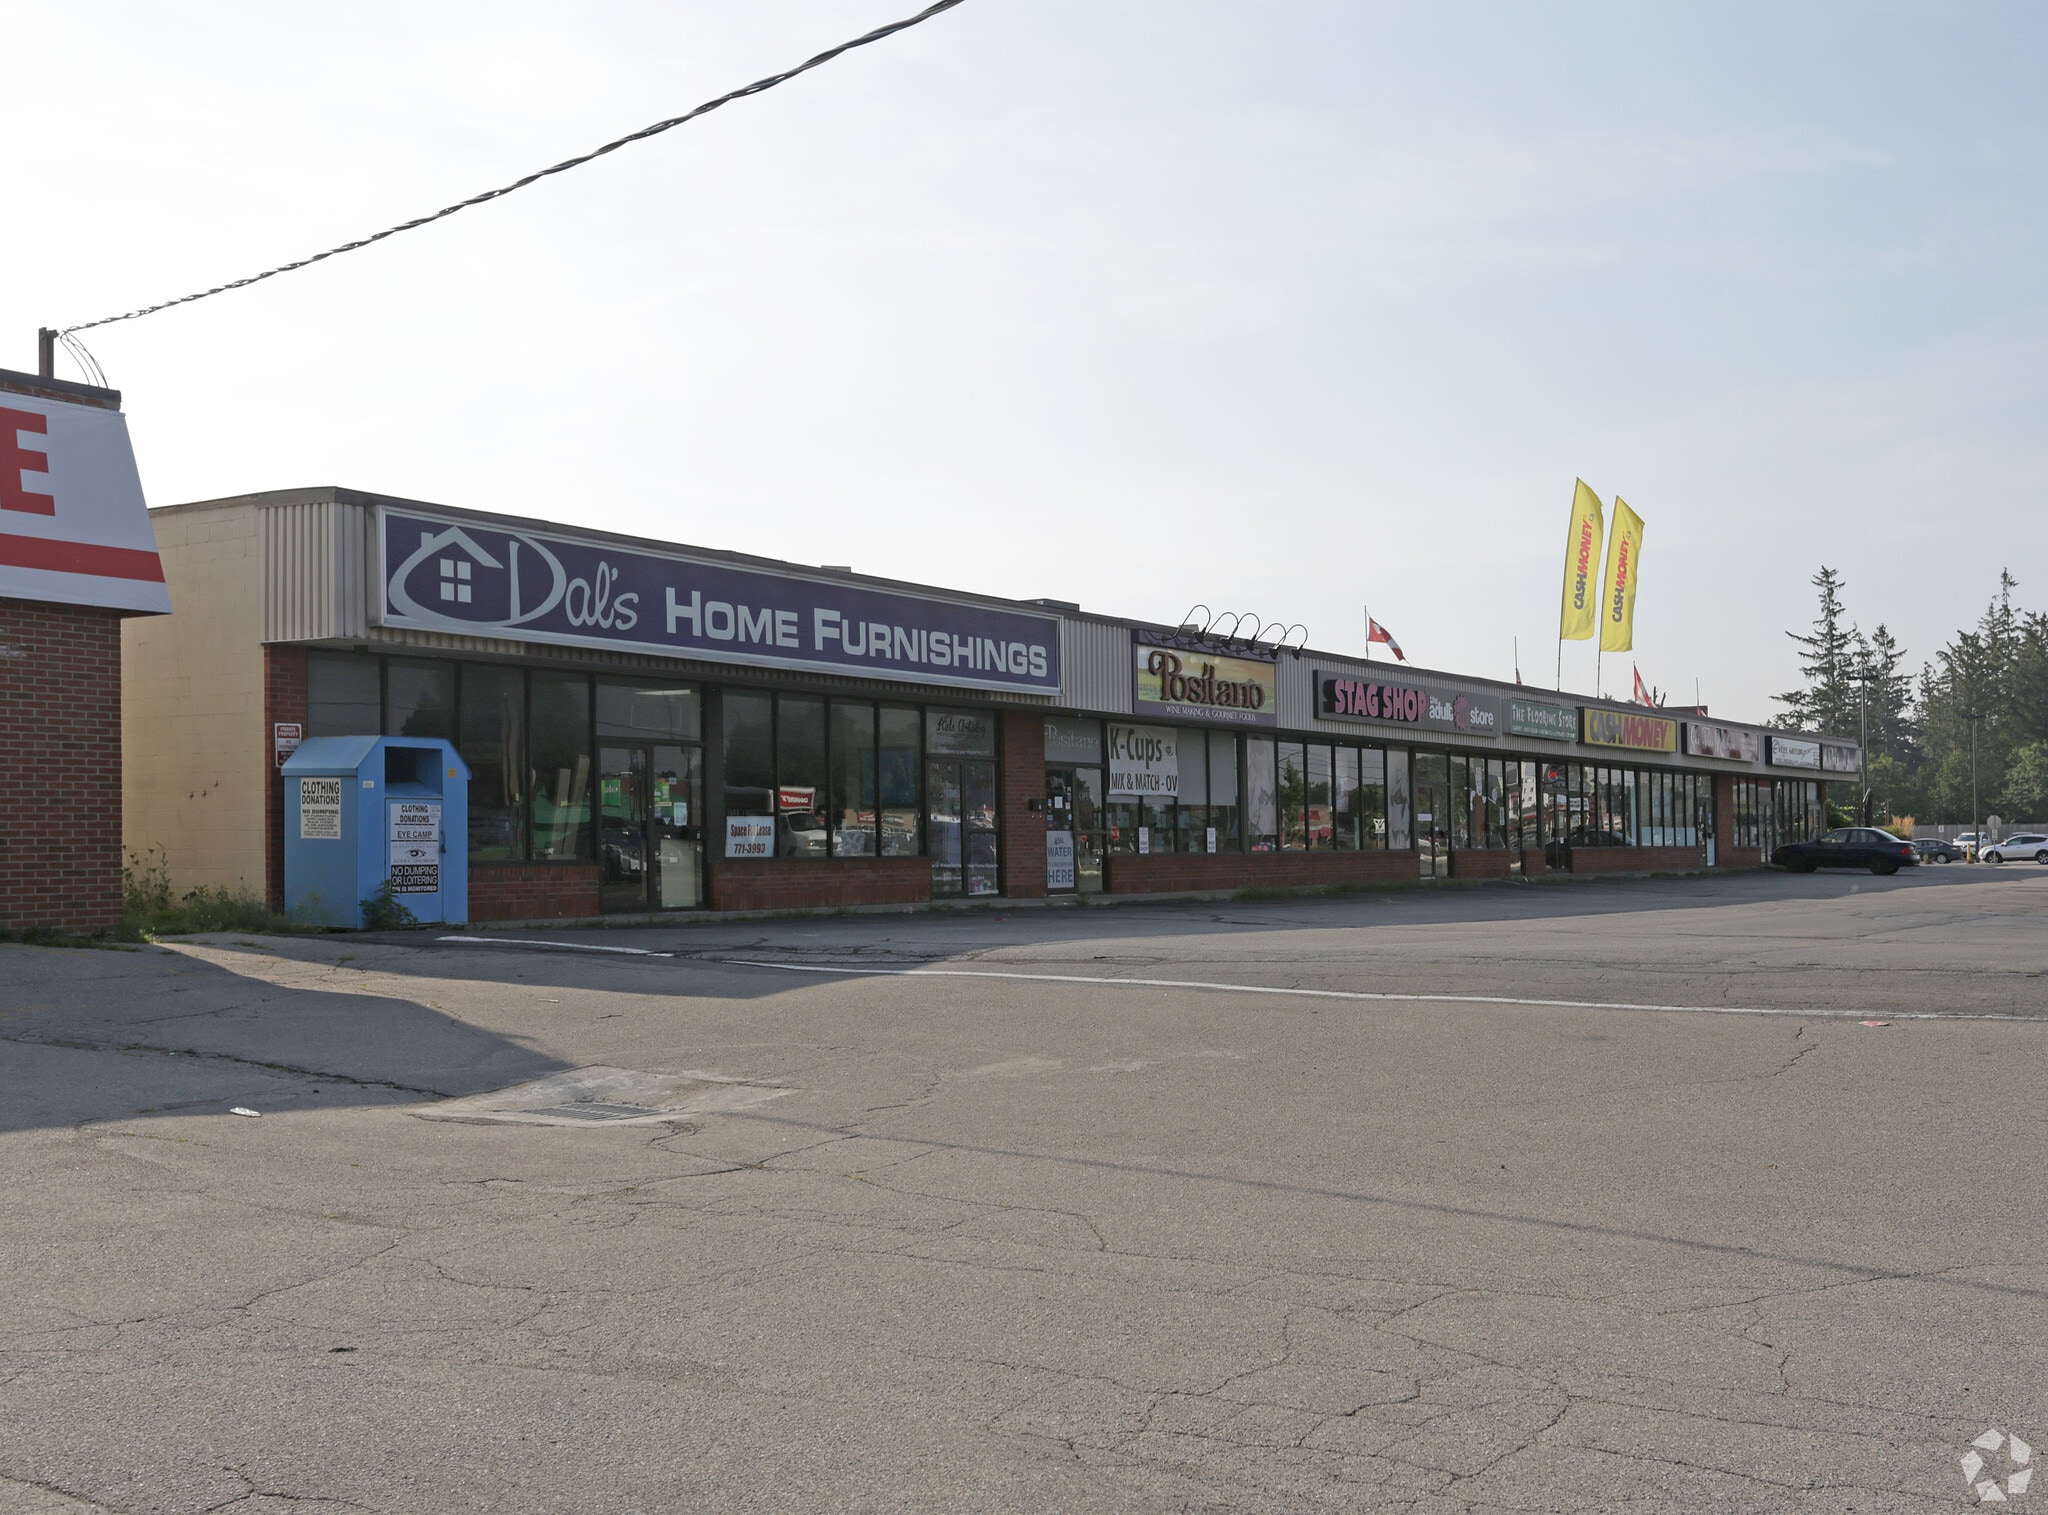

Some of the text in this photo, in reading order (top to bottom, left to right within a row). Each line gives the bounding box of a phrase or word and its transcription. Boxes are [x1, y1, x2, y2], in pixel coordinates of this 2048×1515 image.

[505, 533, 1048, 678] Dal's HOME FURNISHINGS
[1148, 650, 1266, 710] Positano
[1334, 679, 1427, 722] STAG SHOP
[1429, 695, 1438, 705] the
[1166, 705, 1180, 714] WINE
[1182, 706, 1204, 718] MAKING
[1205, 709, 1211, 719] &
[1212, 709, 1238, 720] GOURMET
[1429, 702, 1494, 726] adult store
[1512, 704, 1525, 722] THE
[1110, 728, 1162, 769] K-Cups
[302, 781, 340, 795] CLOTHING
[1111, 772, 1125, 790] MIX
[1127, 773, 1133, 790] &
[1135, 773, 1160, 791] MATCH
[302, 795, 340, 805] DONATIONS
[401, 804, 428, 813] CLOTHING
[400, 815, 430, 823] DONATIONS
[730, 824, 747, 838] Space
[757, 825, 772, 836] Lease
[734, 843, 766, 854] 771-3993
[1047, 846, 1072, 857] WATER
[392, 866, 437, 876] NO DUMPING
[1048, 869, 1073, 883] HERE
[392, 875, 437, 885] OR LOITERING
